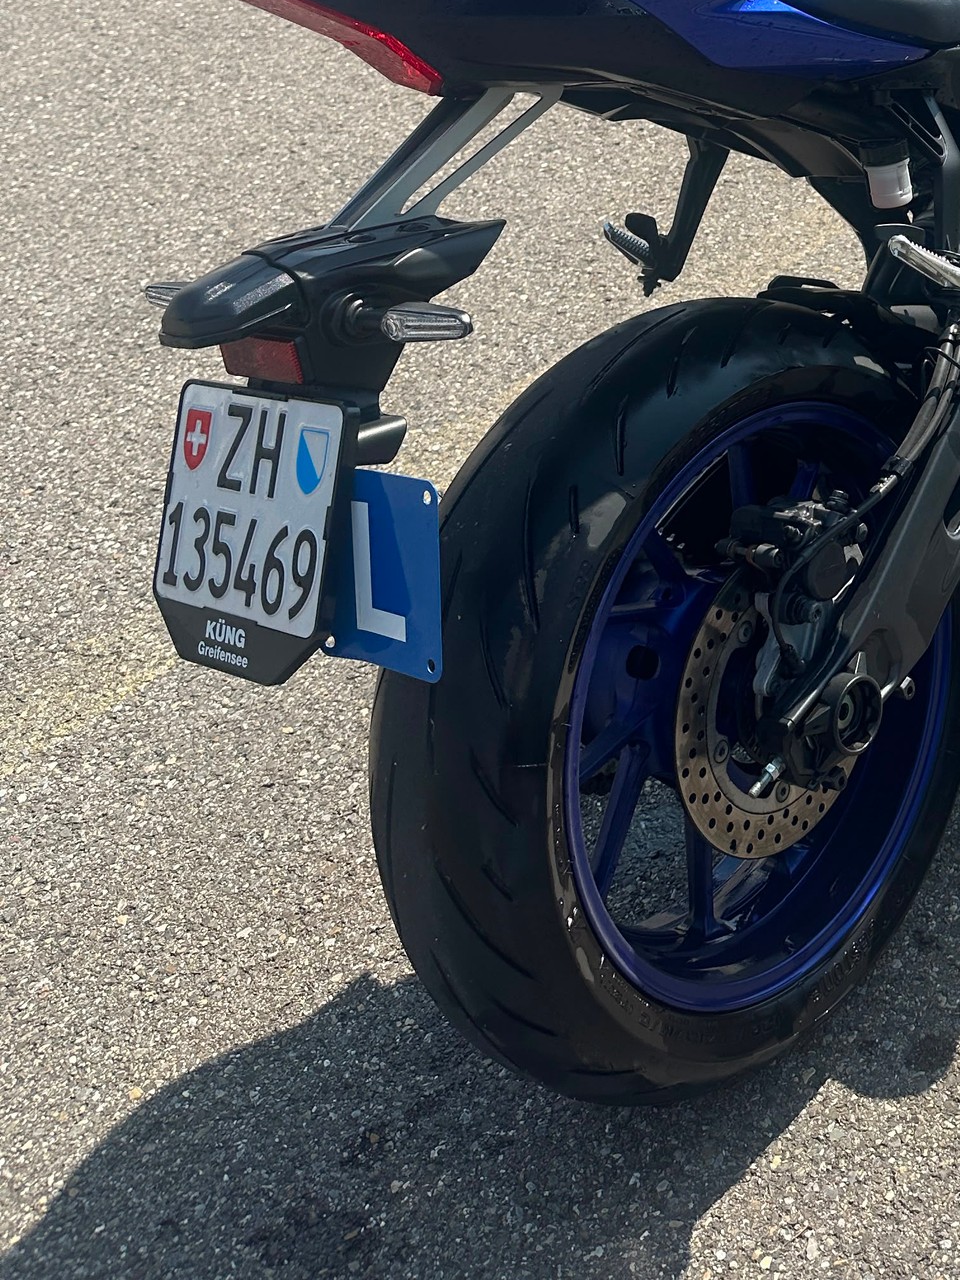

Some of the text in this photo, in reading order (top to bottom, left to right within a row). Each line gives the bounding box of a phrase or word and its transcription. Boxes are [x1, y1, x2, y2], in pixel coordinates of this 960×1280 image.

[216, 403, 287, 499] ZH
[162, 501, 318, 621] 135469
[350, 500, 407, 643] L
[198, 640, 249, 669] Greifensee
[205, 618, 246, 649] KÜNG
